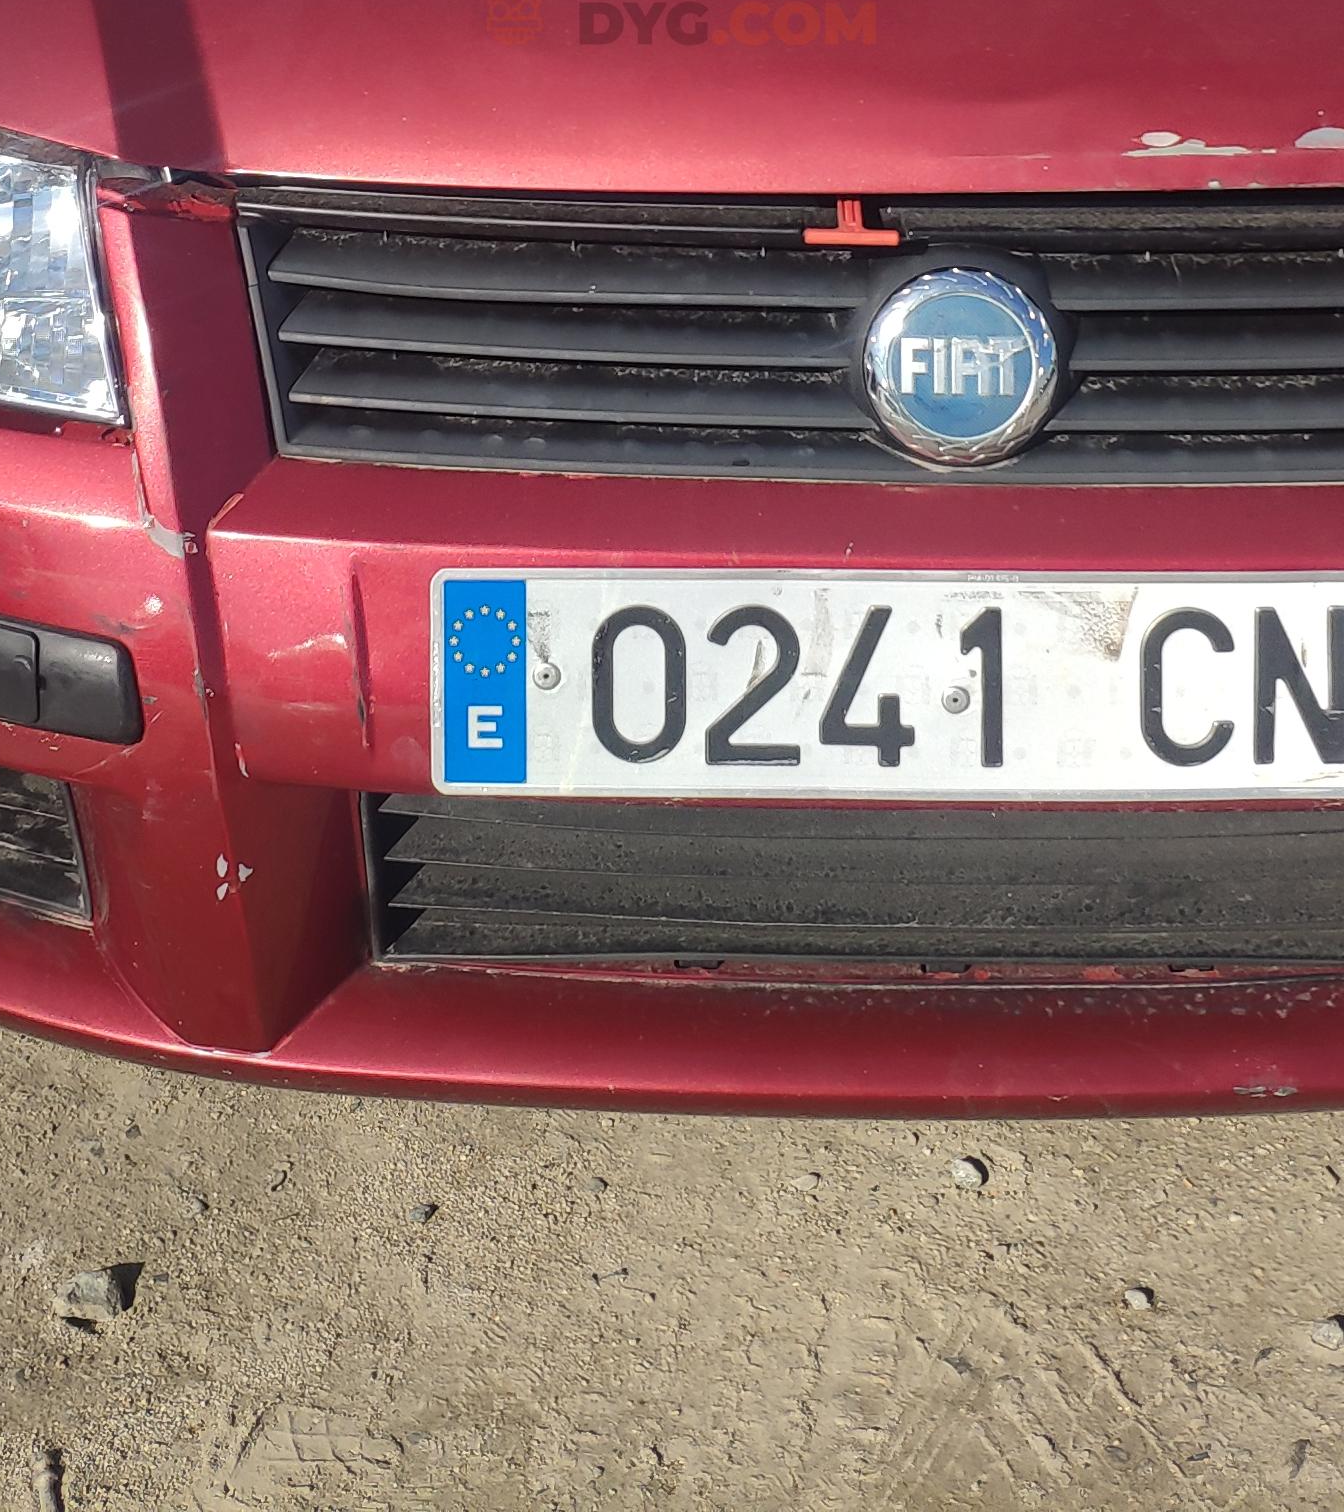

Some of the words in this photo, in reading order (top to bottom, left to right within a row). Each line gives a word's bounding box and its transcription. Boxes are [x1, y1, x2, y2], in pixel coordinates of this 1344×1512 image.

[900, 337, 1026, 396] FIAT
[592, 603, 1002, 768] 0241
[467, 705, 504, 748] E
